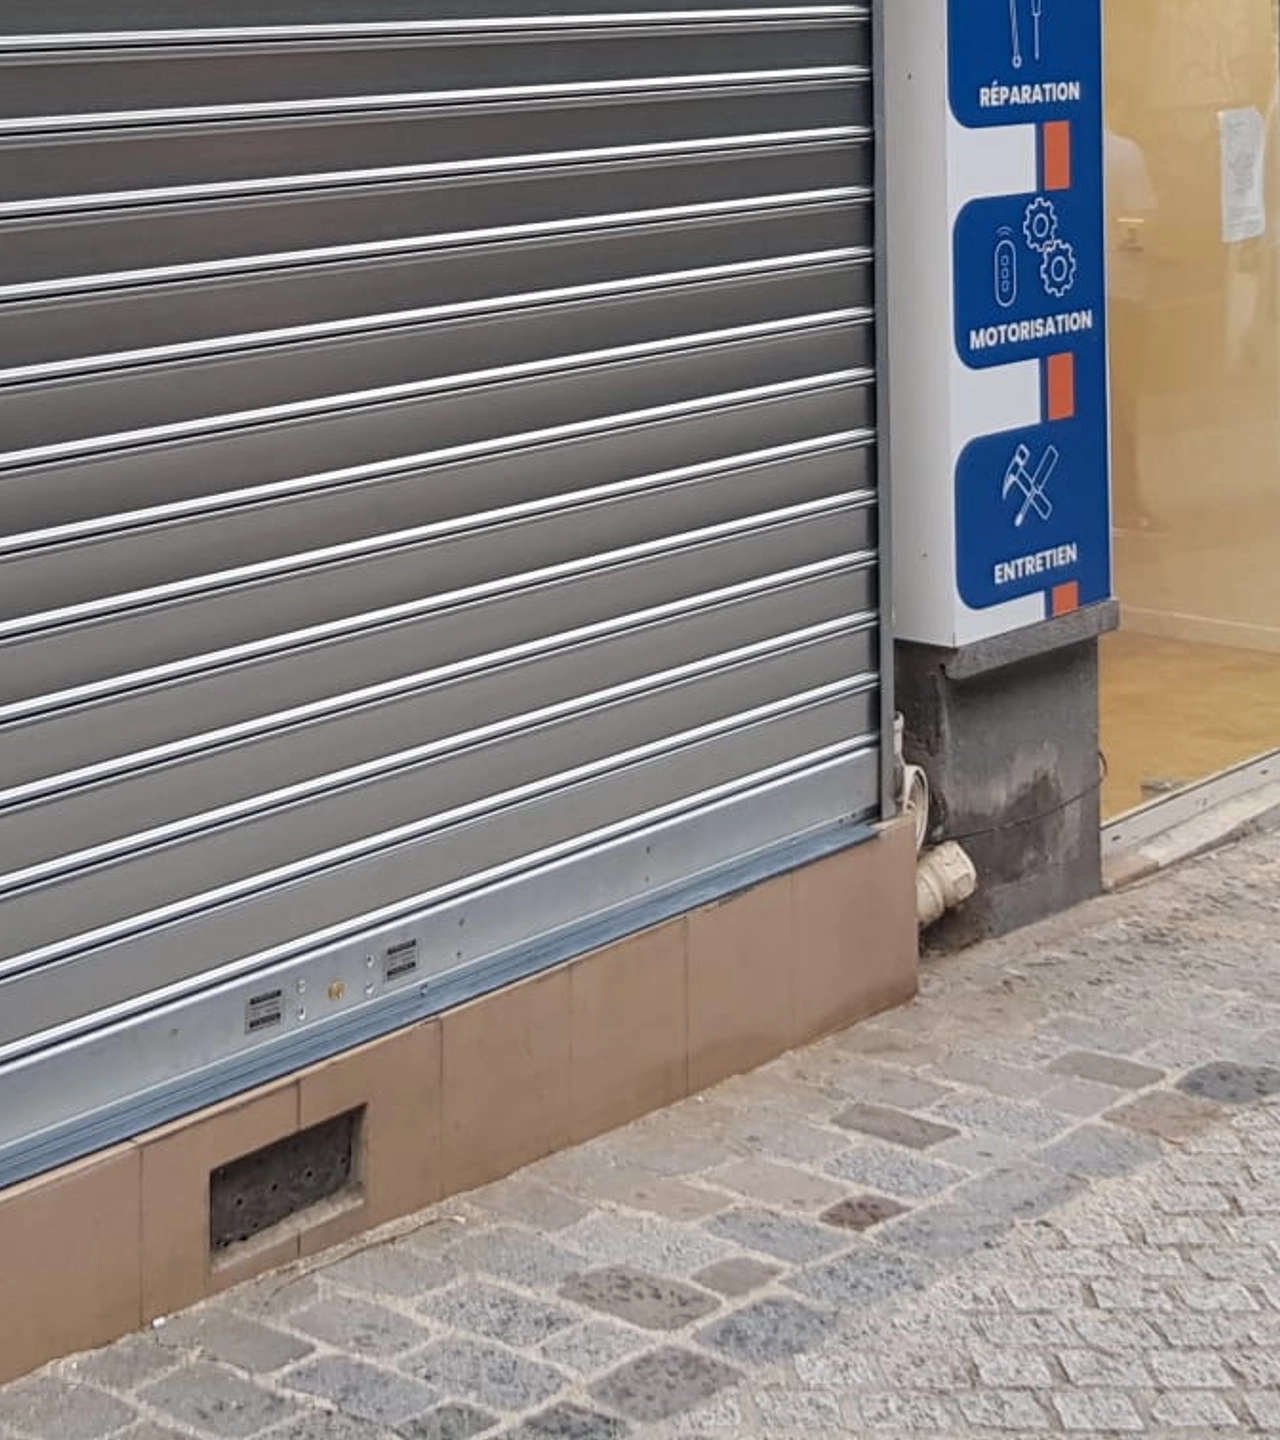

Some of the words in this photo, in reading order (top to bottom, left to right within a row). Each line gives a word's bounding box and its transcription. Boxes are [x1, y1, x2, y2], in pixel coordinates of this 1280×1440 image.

[979, 81, 1080, 108] RÉPARATION
[969, 310, 1093, 350] MOTORISATION
[994, 543, 1078, 585] ENTRETIEN
